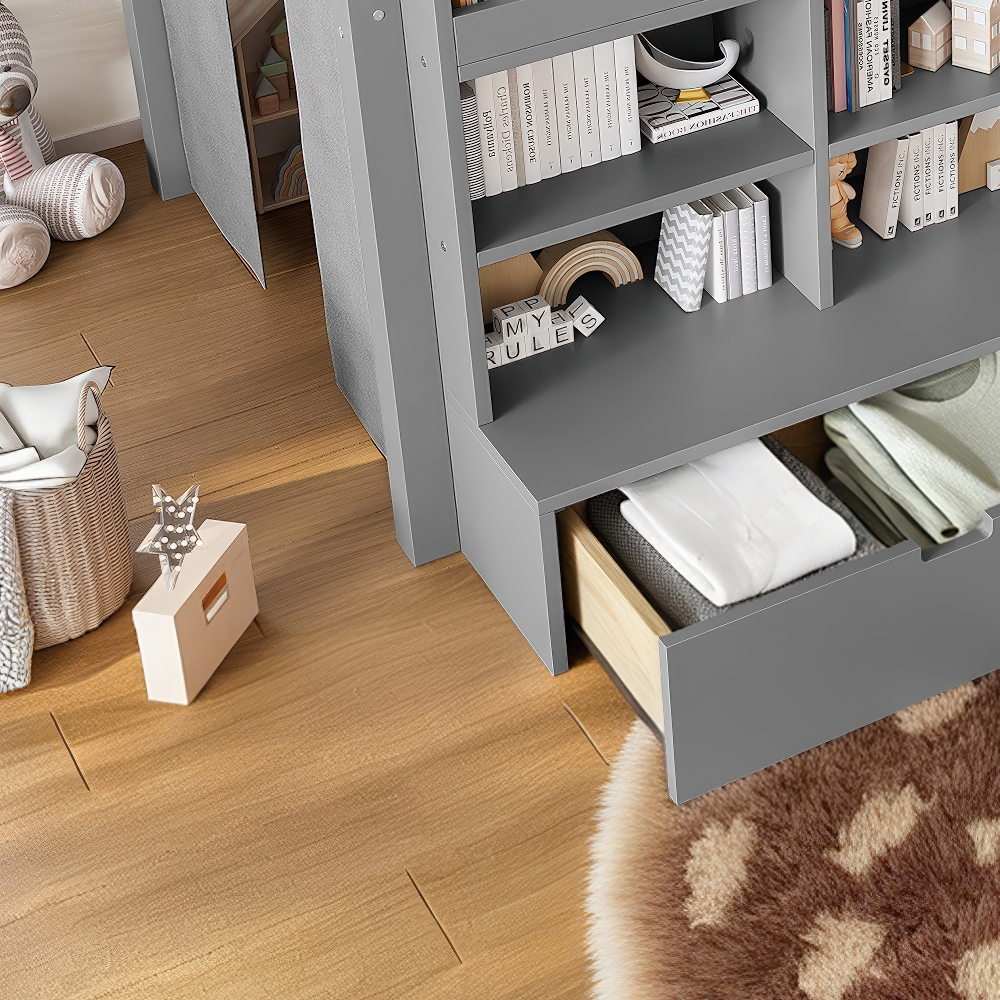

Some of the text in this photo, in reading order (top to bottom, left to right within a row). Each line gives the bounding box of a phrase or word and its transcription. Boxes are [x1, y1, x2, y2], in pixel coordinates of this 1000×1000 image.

[892, 150, 906, 208] FICTIONS INC.
[506, 310, 546, 338] MY
